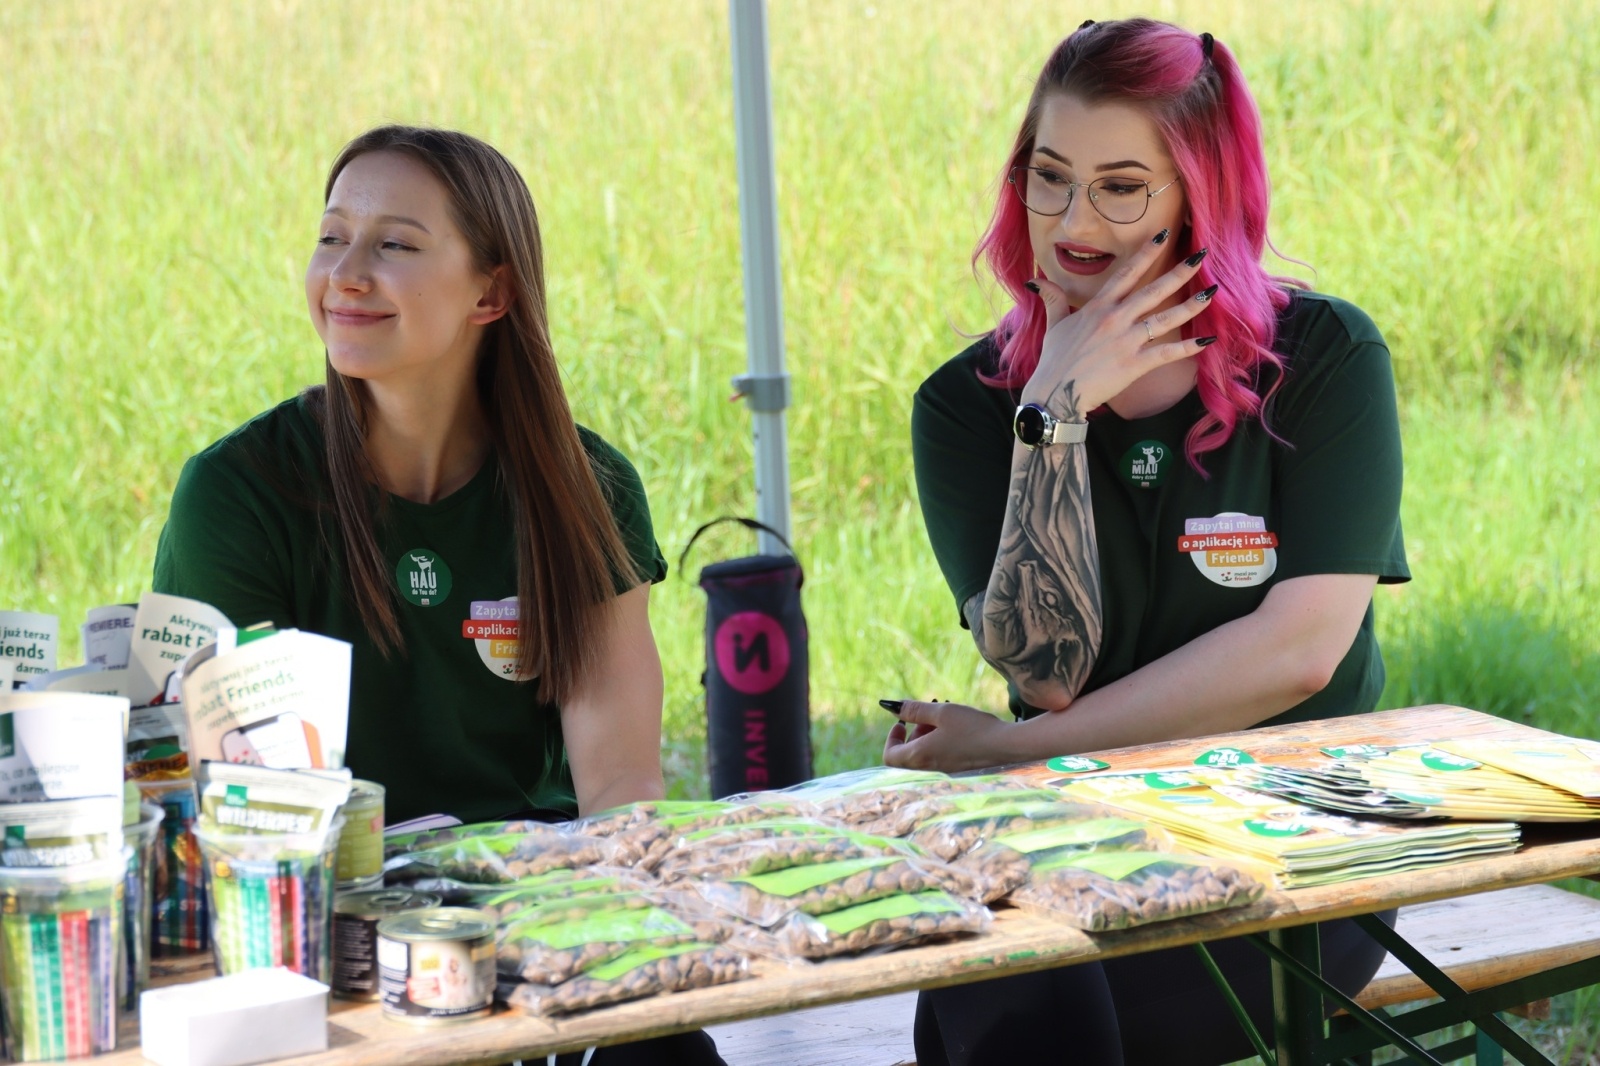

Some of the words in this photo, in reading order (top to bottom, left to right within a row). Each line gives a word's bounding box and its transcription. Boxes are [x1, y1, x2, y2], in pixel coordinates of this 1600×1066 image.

[1132, 464, 1158, 475] MIAU
[1190, 519, 1233, 532] Zapytaj
[1236, 520, 1261, 529] mnie
[1182, 540, 1190, 548] o
[1192, 535, 1242, 549] aplikację
[1244, 535, 1248, 545] i
[1211, 551, 1260, 564] Friends
[409, 571, 437, 589] HAU
[4, 627, 21, 640] już
[23, 629, 51, 641] teraz
[142, 626, 192, 648] rabat
[196, 636, 206, 648] F
[467, 625, 475, 634] o
[477, 623, 520, 638] aplikacj
[0, 641, 45, 660] iends
[495, 642, 520, 655] Frie
[226, 669, 296, 703] Friends
[744, 709, 769, 792] INVE
